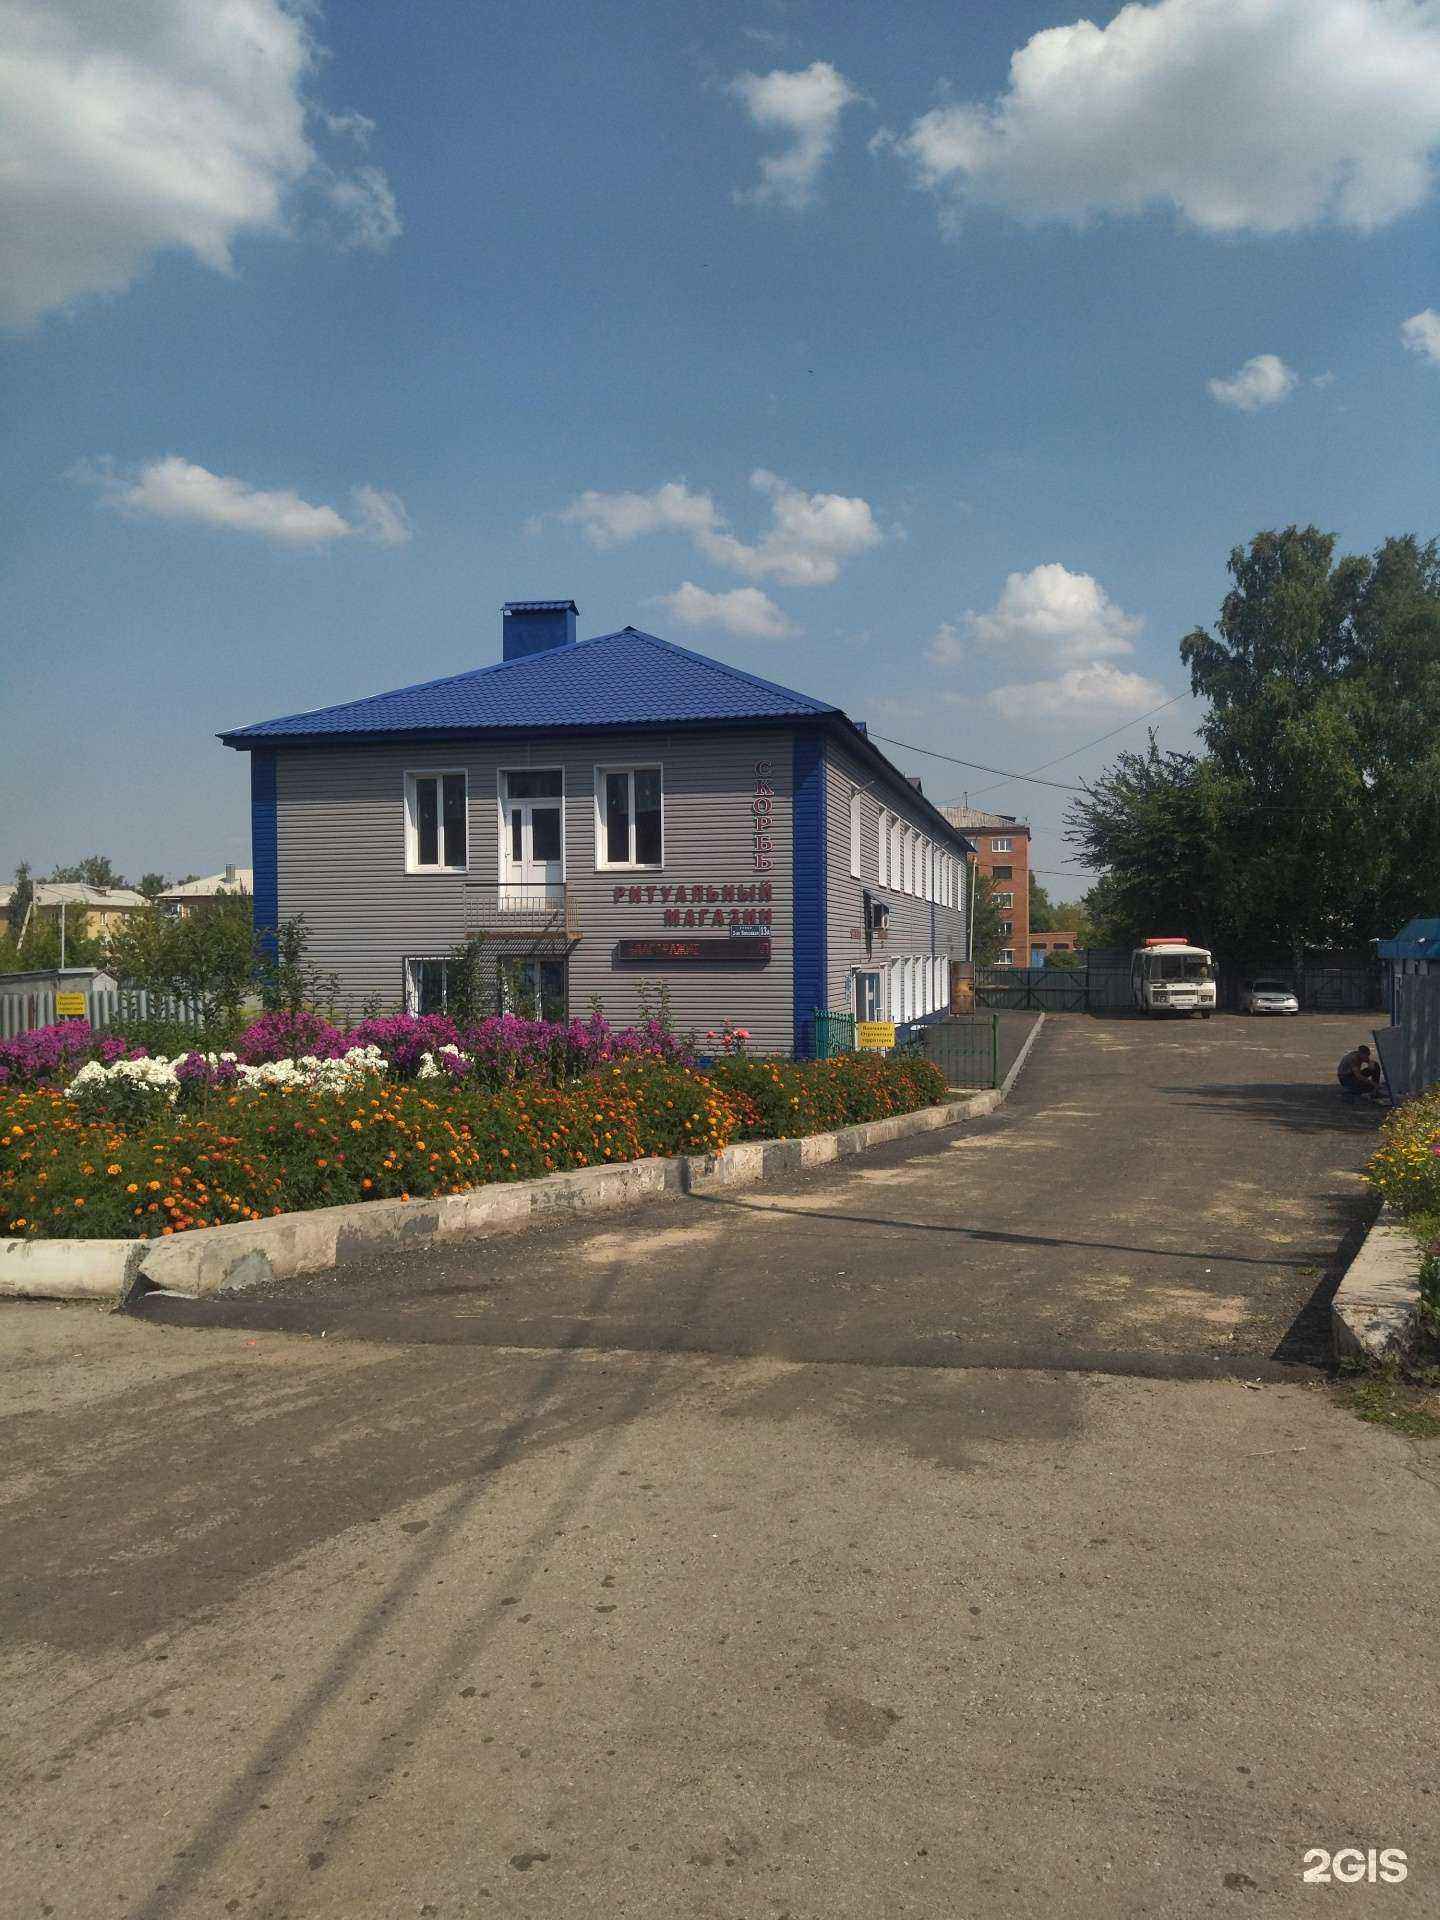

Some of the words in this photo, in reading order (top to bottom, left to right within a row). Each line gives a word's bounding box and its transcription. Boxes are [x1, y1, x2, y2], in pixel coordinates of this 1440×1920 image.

[753, 760, 775, 872] СКОРБЬ
[613, 881, 772, 904] РИТУАЛЬНЫЙ
[664, 908, 772, 927] МАГАЗИН
